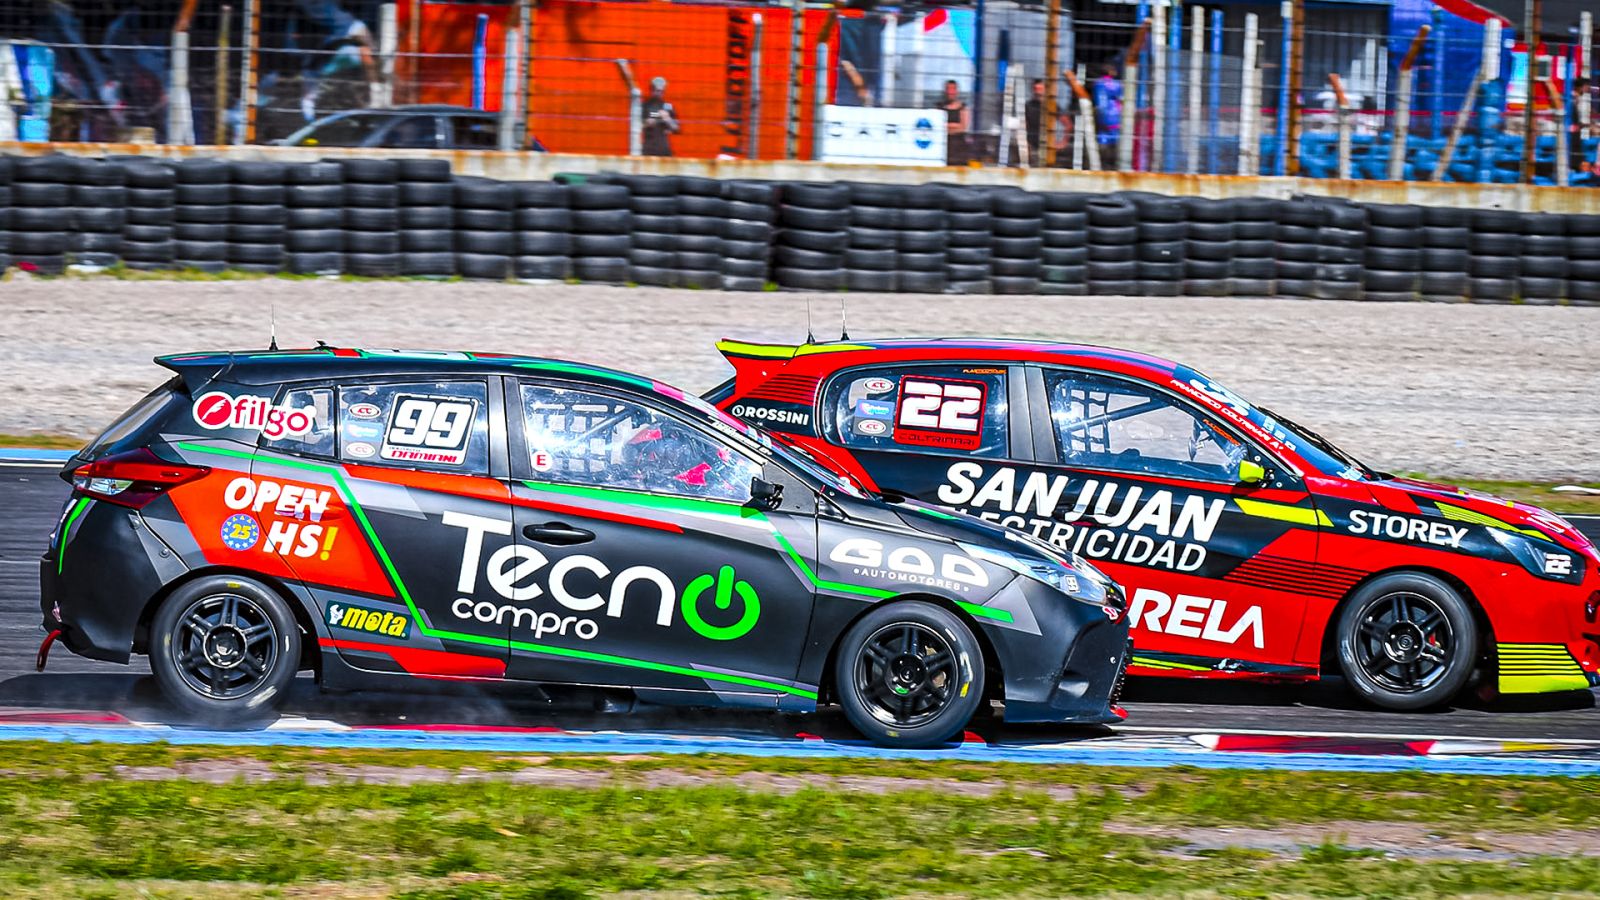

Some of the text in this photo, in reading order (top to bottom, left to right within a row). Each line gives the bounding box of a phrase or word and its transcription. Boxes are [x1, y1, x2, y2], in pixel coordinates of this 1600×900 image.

[235, 399, 309, 436] filgo
[389, 400, 473, 448] 99
[744, 406, 809, 426] ROSSINI
[900, 381, 981, 432] 22
[537, 454, 547, 466] E
[224, 477, 332, 522] OPEN
[938, 461, 1226, 542] SAN JUAN
[229, 520, 339, 561] 25 HS!
[1347, 509, 1469, 548] STOREY
[861, 568, 960, 591] AUTOMOTORES
[340, 607, 407, 637] mota
[451, 597, 599, 640] compro
